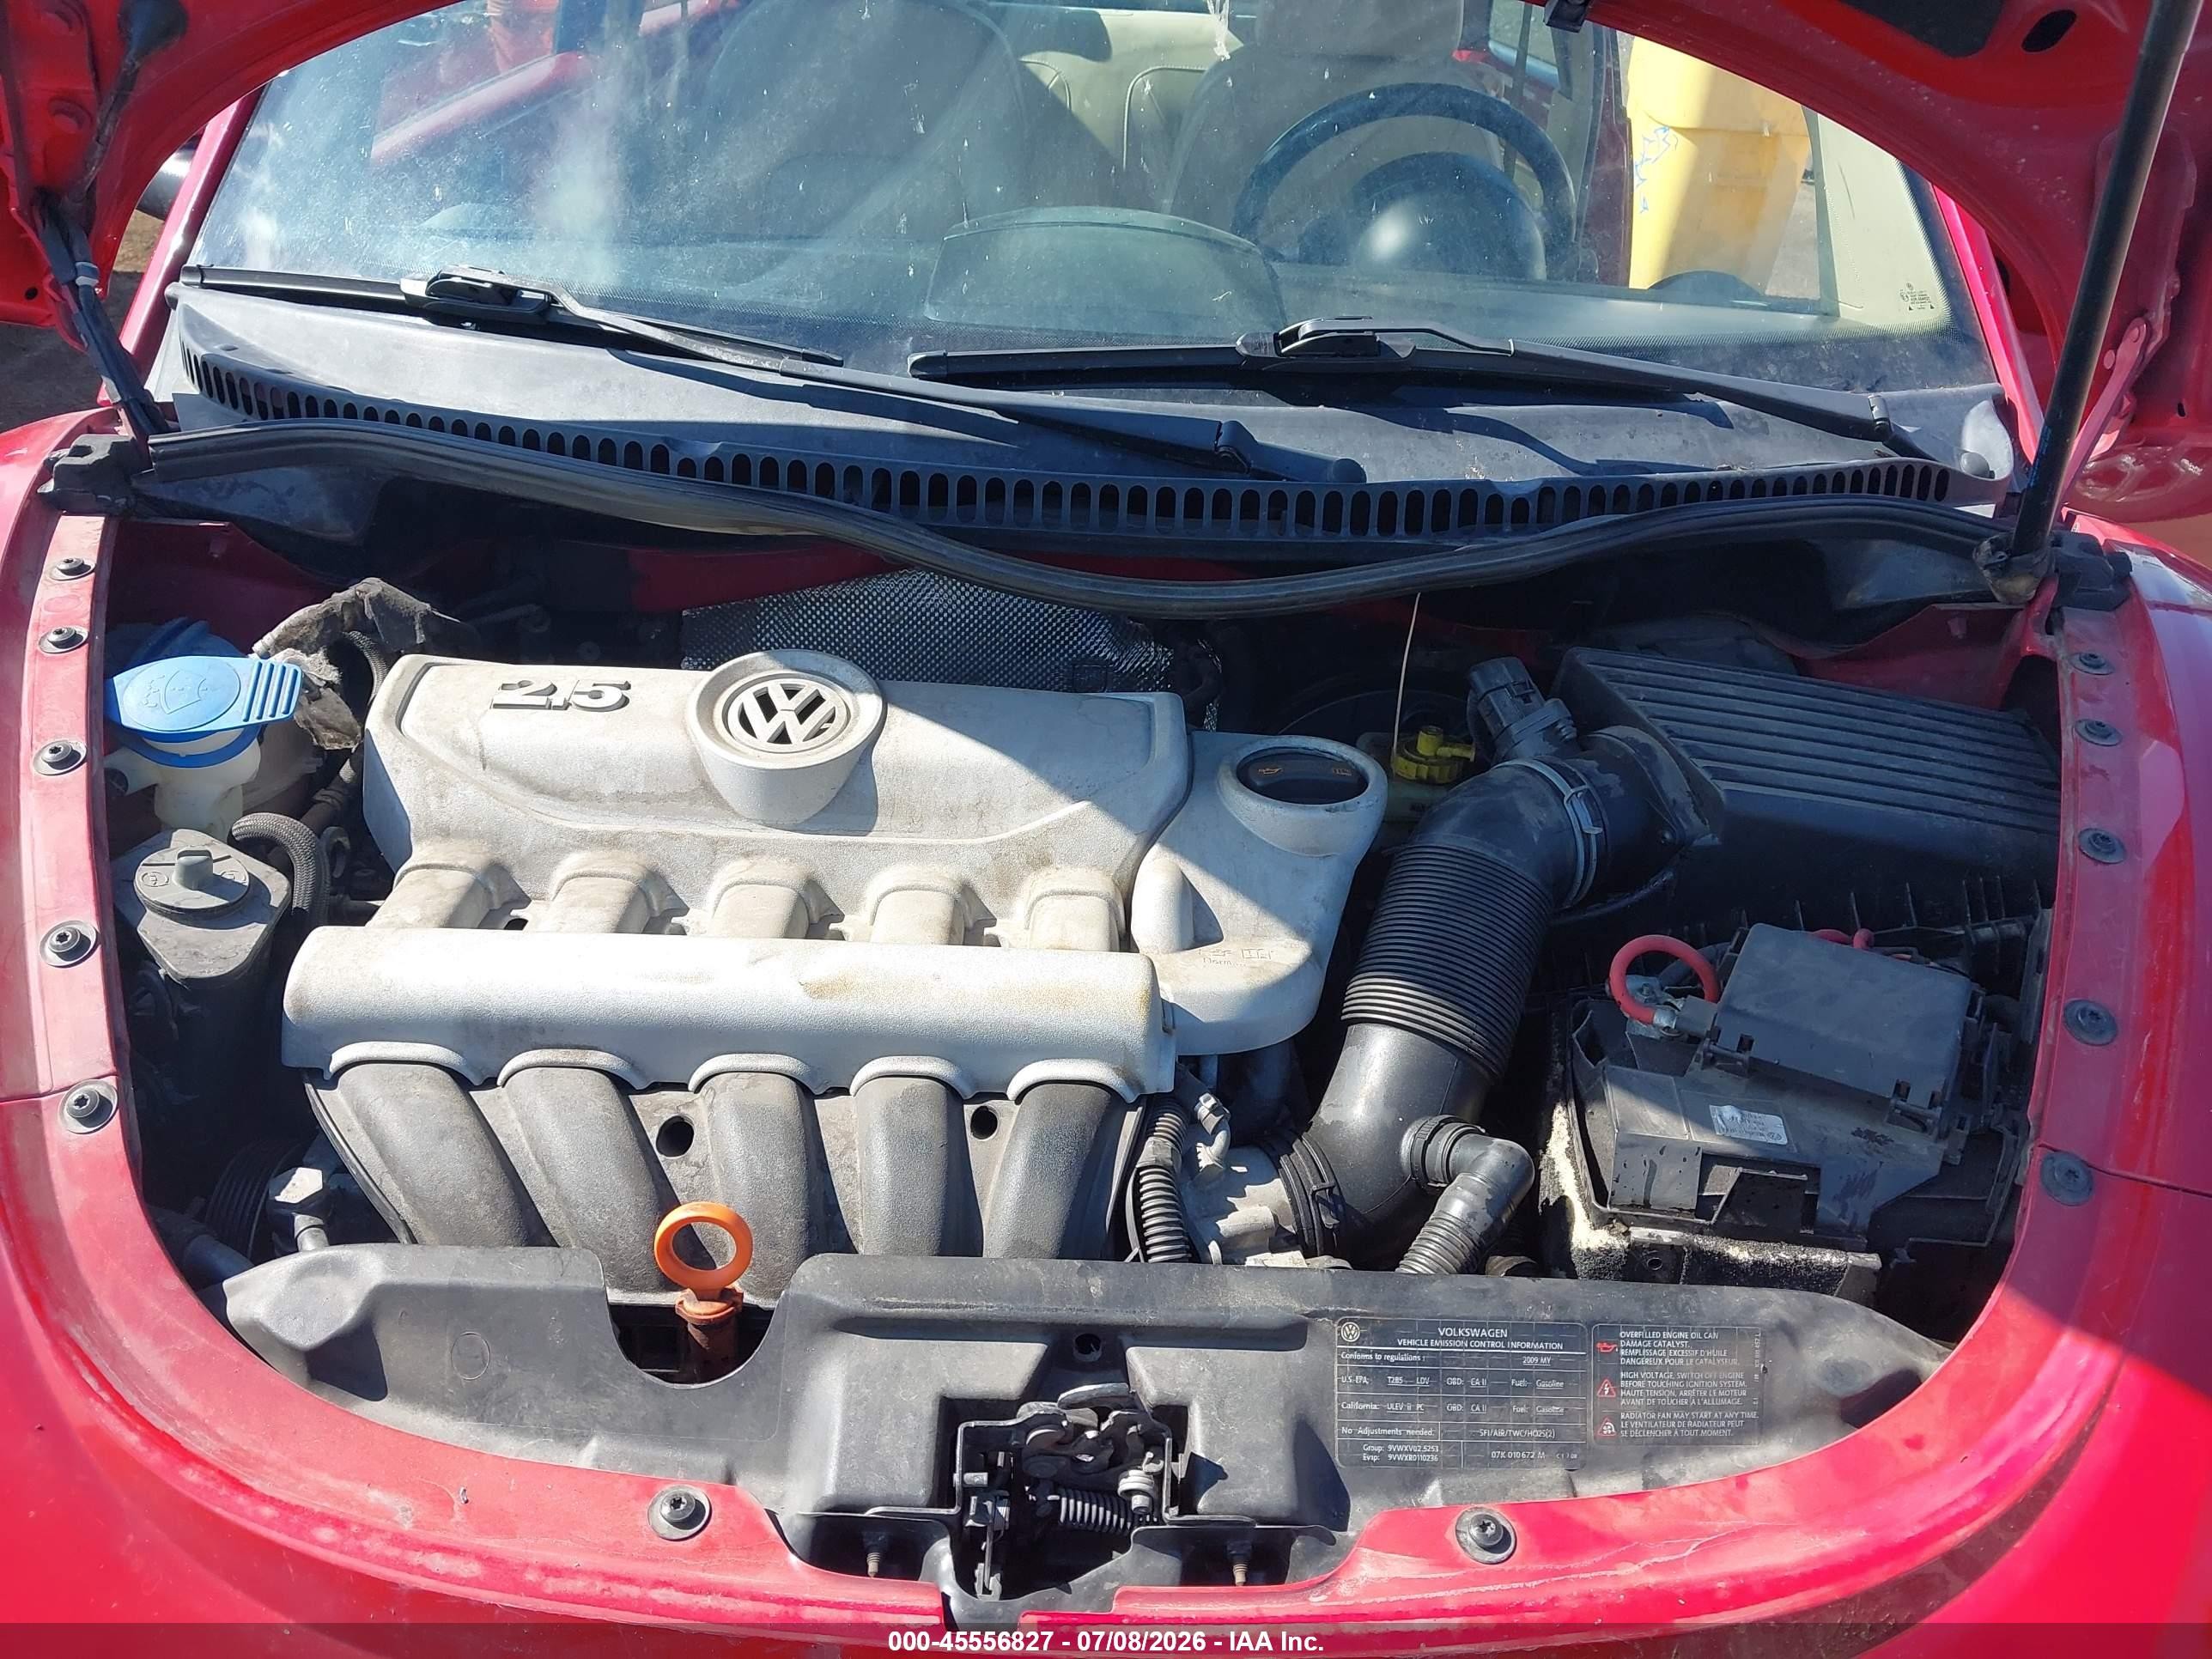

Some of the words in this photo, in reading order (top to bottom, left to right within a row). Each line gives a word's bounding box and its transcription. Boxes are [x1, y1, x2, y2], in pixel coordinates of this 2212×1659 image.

[1340, 1322, 1360, 1342] VW
[1438, 1328, 1508, 1338] VOLKSWAGEN
[1507, 1341, 1563, 1350] INFORMATION
[1383, 1353, 1420, 1362] regulations
[1358, 1427, 1401, 1436] Adjustments
[1364, 1444, 1384, 1453] Group:
[1363, 1454, 1380, 1462] Evap:
